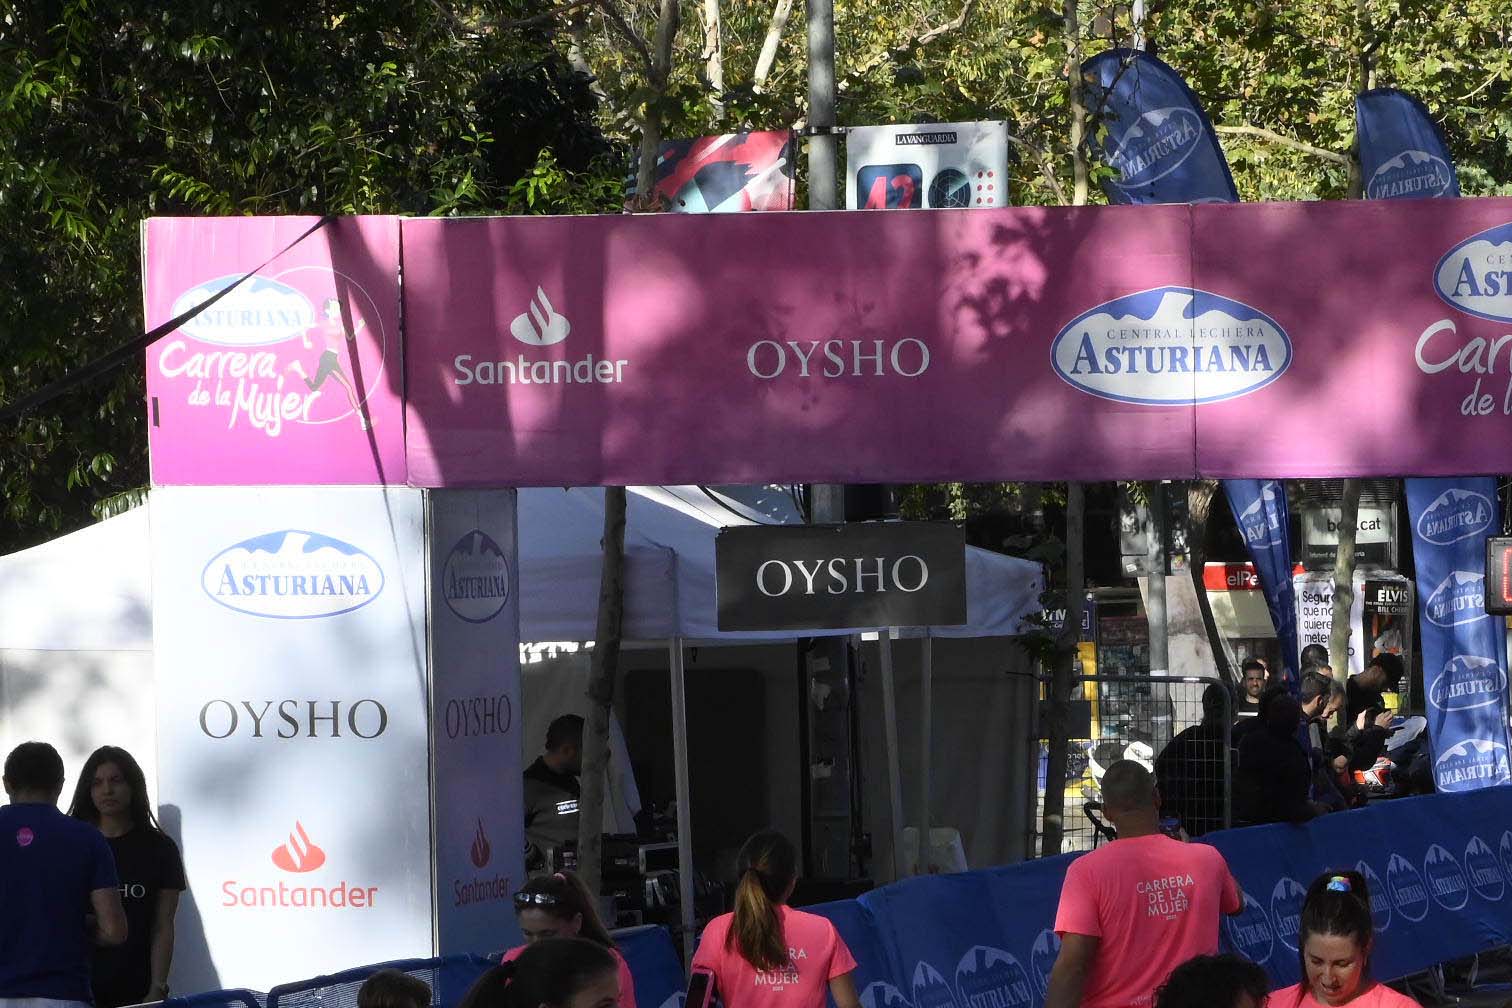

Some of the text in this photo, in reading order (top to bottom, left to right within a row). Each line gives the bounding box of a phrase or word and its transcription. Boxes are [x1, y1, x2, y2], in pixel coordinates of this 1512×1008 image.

[1107, 326, 1265, 339] CENTRAL LECHERA
[159, 340, 277, 382] Carrera
[454, 353, 629, 386] Santander
[746, 337, 931, 380] OYSHO
[1070, 331, 1273, 375] ASTURIANA
[187, 366, 322, 437] de la Mujer
[1461, 378, 1496, 416] de
[216, 563, 371, 597] ASTURIANA
[447, 565, 506, 600] ASTURIANA
[756, 555, 929, 598] OYSHO
[1377, 589, 1409, 602] ELVIS
[1303, 617, 1333, 632] quiere
[199, 698, 388, 739] OYSHO
[445, 695, 511, 739] OYSHO
[222, 880, 378, 908] Santander
[455, 873, 511, 907] Santander
[1136, 873, 1194, 894] CARRERA
[1148, 887, 1186, 905] DE LA
[1147, 898, 1189, 917] MUJER
[754, 972, 799, 986] MUJER
